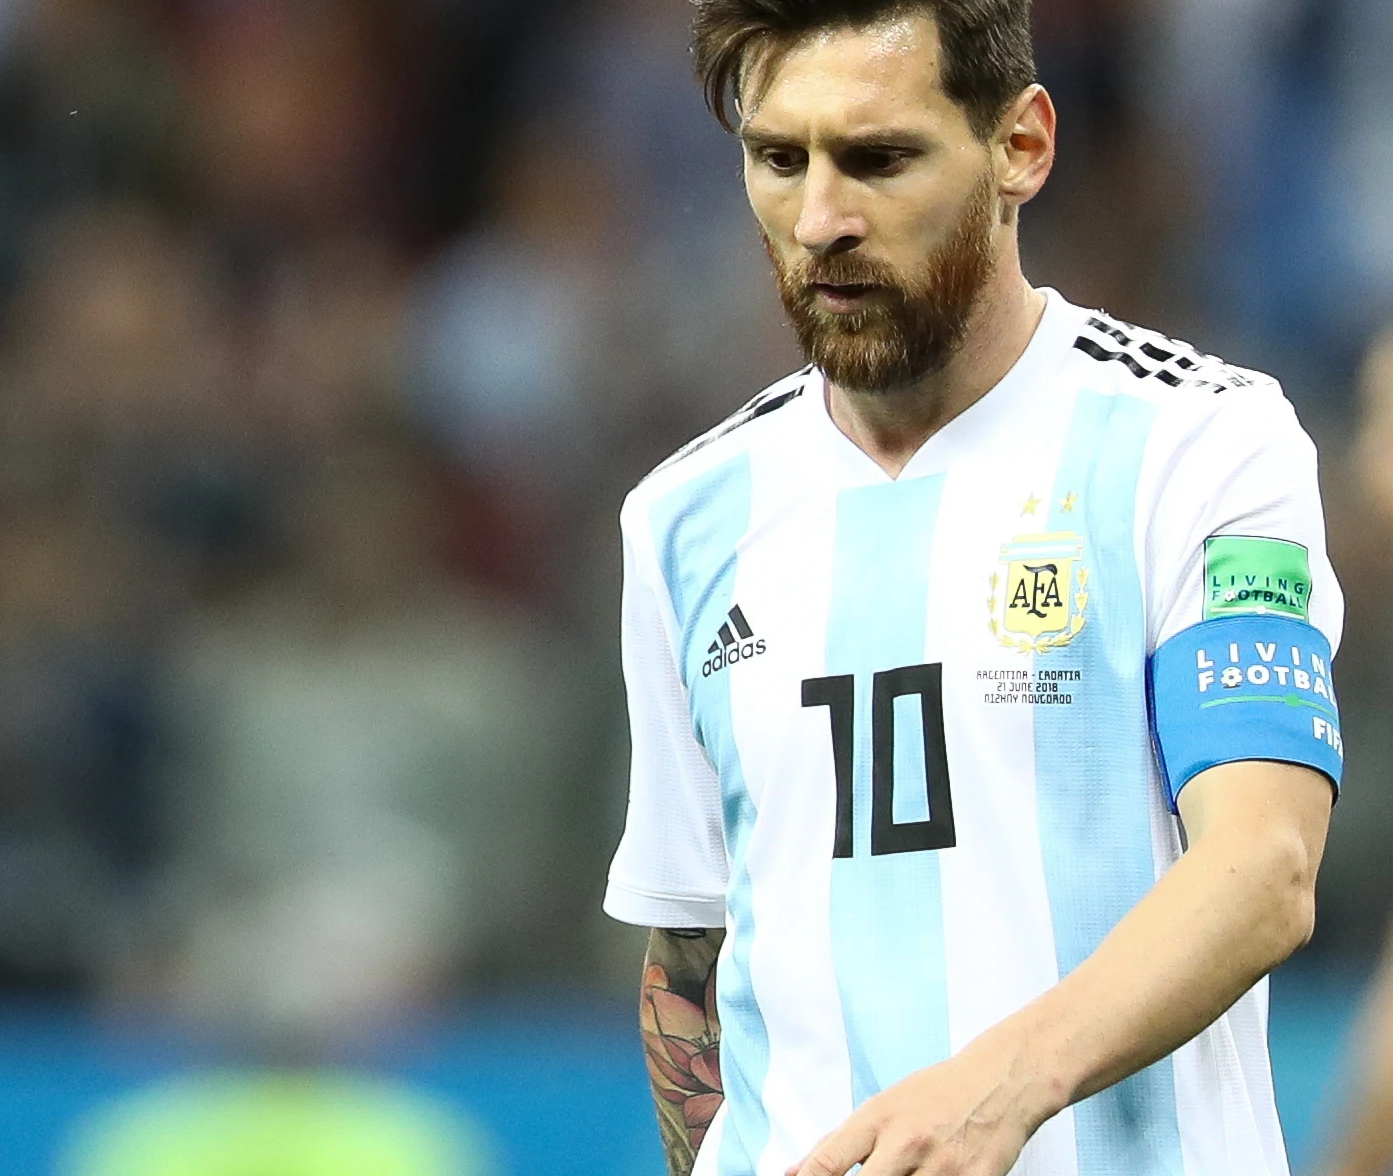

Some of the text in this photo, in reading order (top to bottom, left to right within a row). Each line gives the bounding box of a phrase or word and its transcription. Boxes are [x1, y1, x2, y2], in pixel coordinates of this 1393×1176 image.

[1009, 563, 1063, 618] AFA
[1212, 575, 1305, 595] LIVING
[1212, 589, 1304, 609] FOOTBALL
[702, 638, 767, 678] adidas
[1195, 642, 1332, 678] LIVIN
[976, 670, 1028, 680] ARGENTINA
[1038, 670, 1081, 681] CROATIA
[997, 681, 1059, 693] 21 JUNE 2018
[1196, 664, 1338, 708] FOOTBAL
[984, 693, 1072, 704] NIZHNY NOVGOROD
[801, 662, 957, 860] 10
